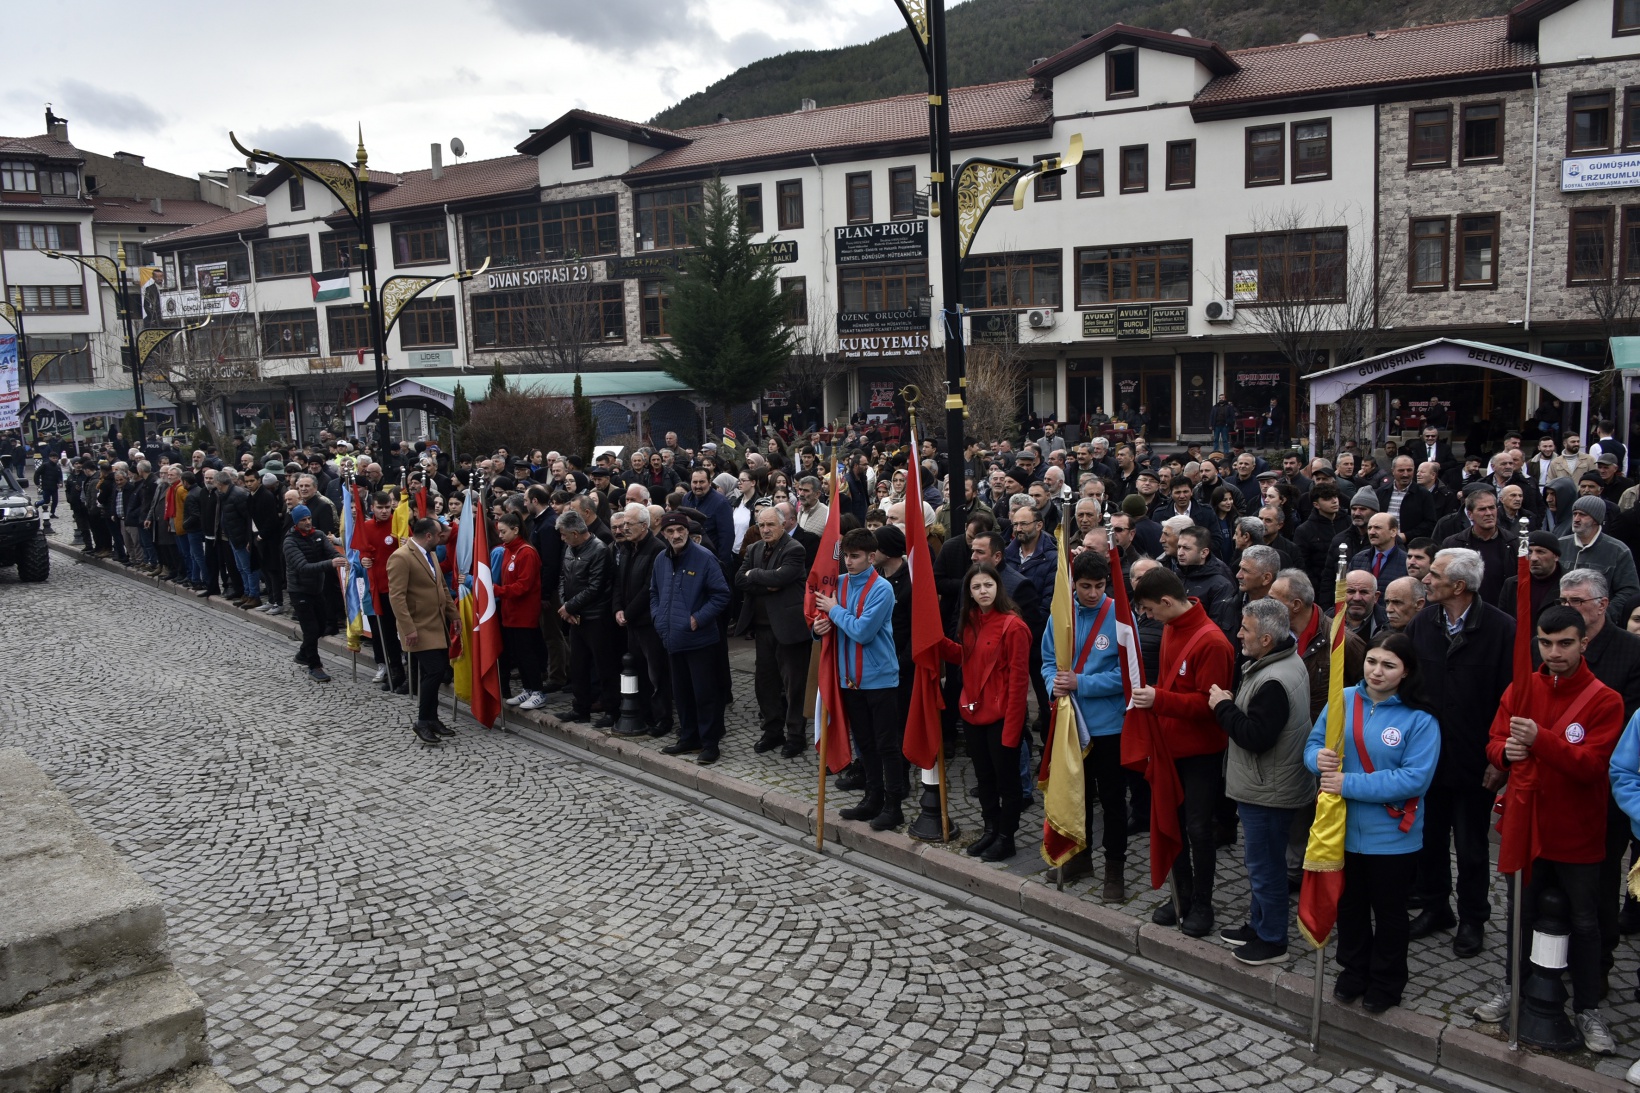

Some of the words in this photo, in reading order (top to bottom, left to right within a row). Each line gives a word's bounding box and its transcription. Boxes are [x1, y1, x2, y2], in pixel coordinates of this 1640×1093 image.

[837, 226, 874, 240] PLAN
[882, 222, 924, 236] PROJE
[750, 243, 794, 256] AVKAT
[522, 266, 570, 286] SOFRASI
[572, 265, 588, 280] 29
[842, 312, 870, 322] ÖZENÇ
[876, 310, 918, 320] ORUÇOĞL
[839, 332, 929, 351] KURUYEMİŞ
[420, 352, 440, 360] LİDER
